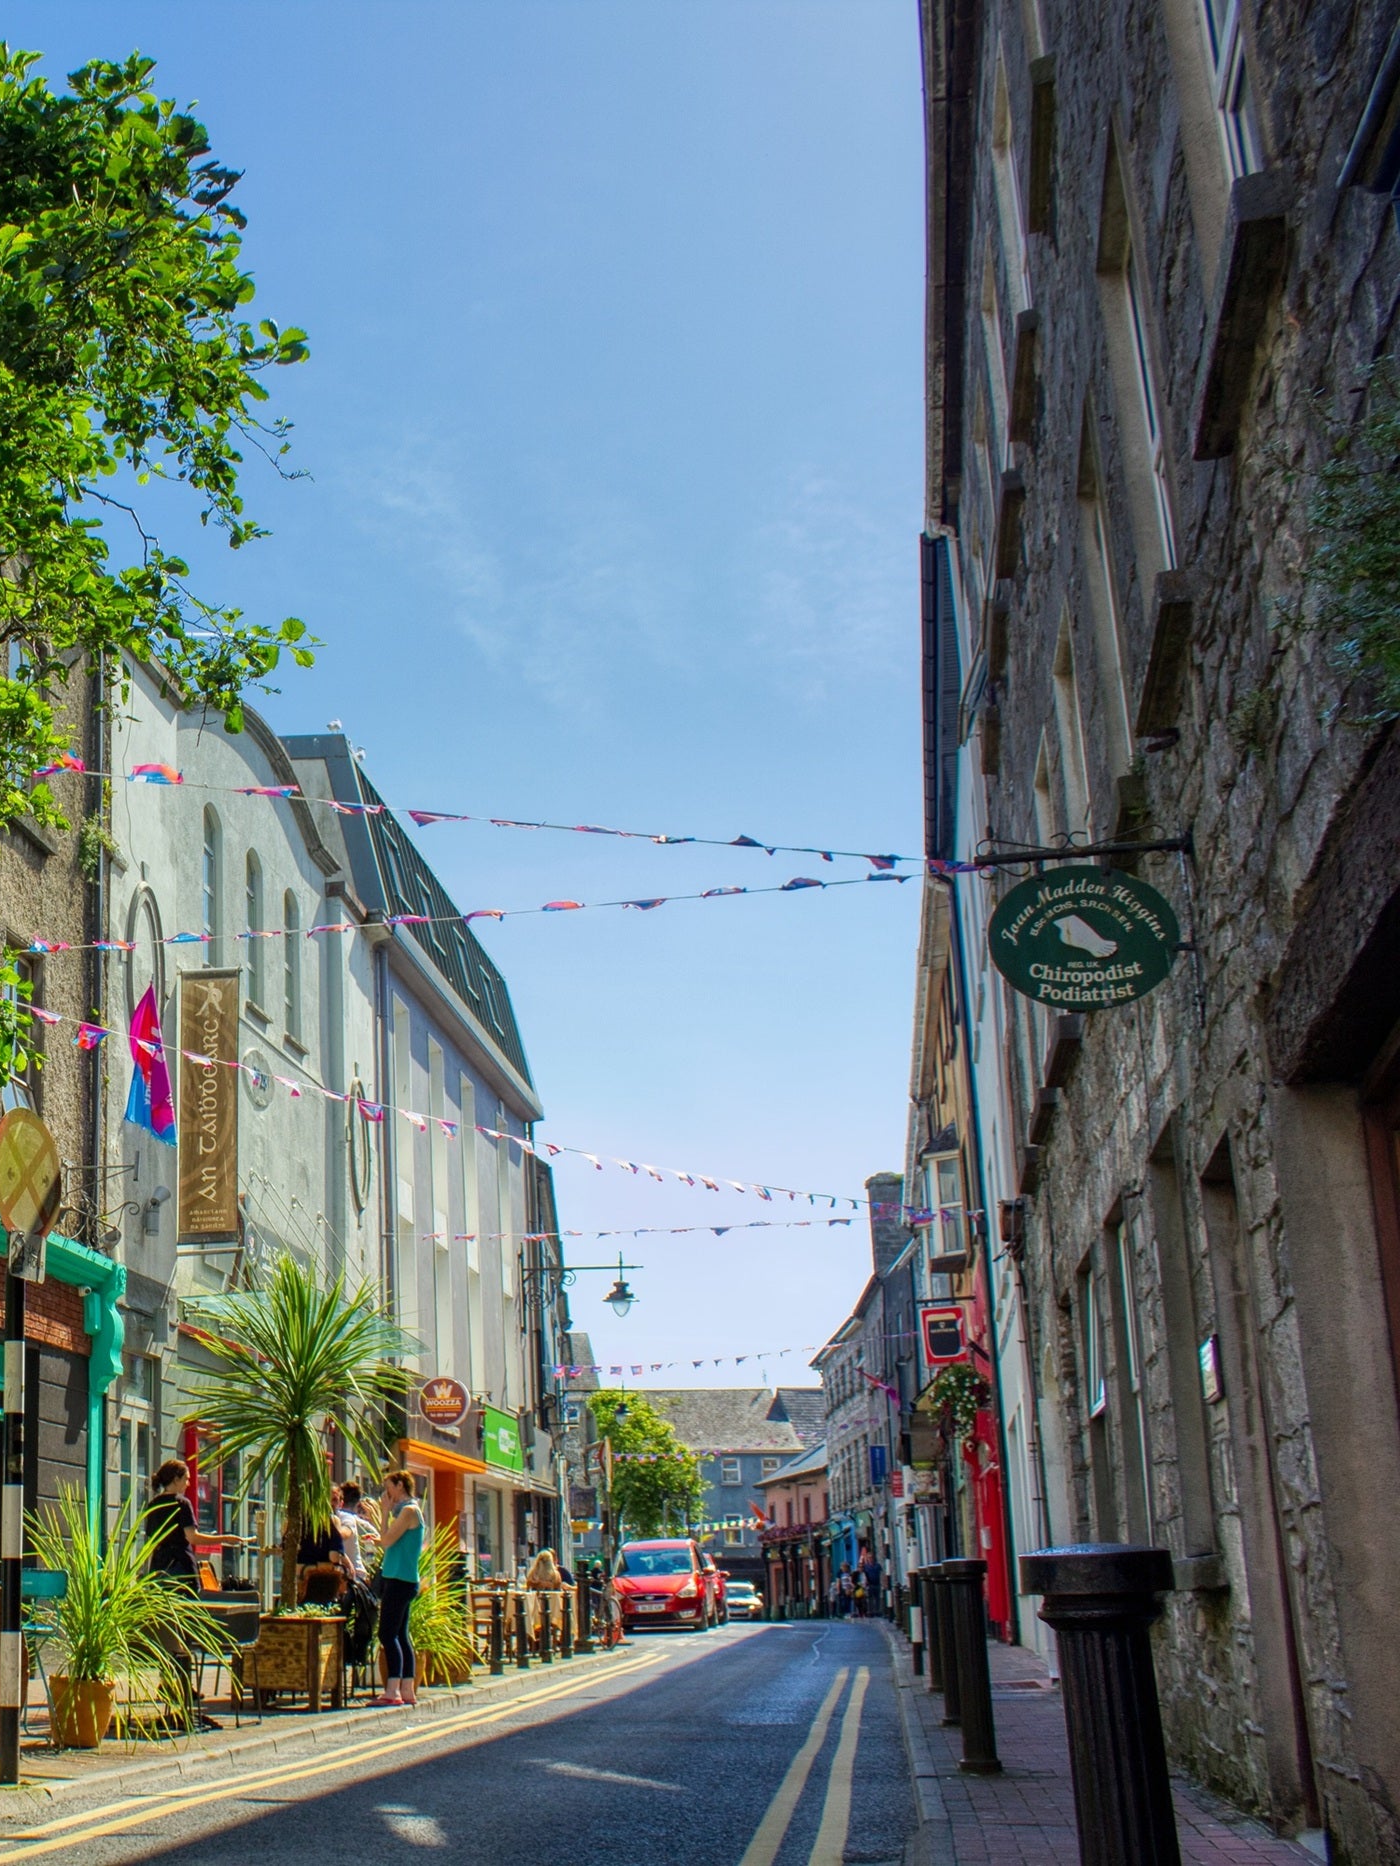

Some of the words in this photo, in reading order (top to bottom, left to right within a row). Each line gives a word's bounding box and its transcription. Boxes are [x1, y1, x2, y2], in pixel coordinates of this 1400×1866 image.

[1001, 905, 1034, 945] Joan
[1036, 878, 1106, 908] Madden
[1111, 885, 1166, 941] Higgins
[1029, 961, 1143, 987] Chiropodist
[1037, 982, 1135, 1002] Podiatrist
